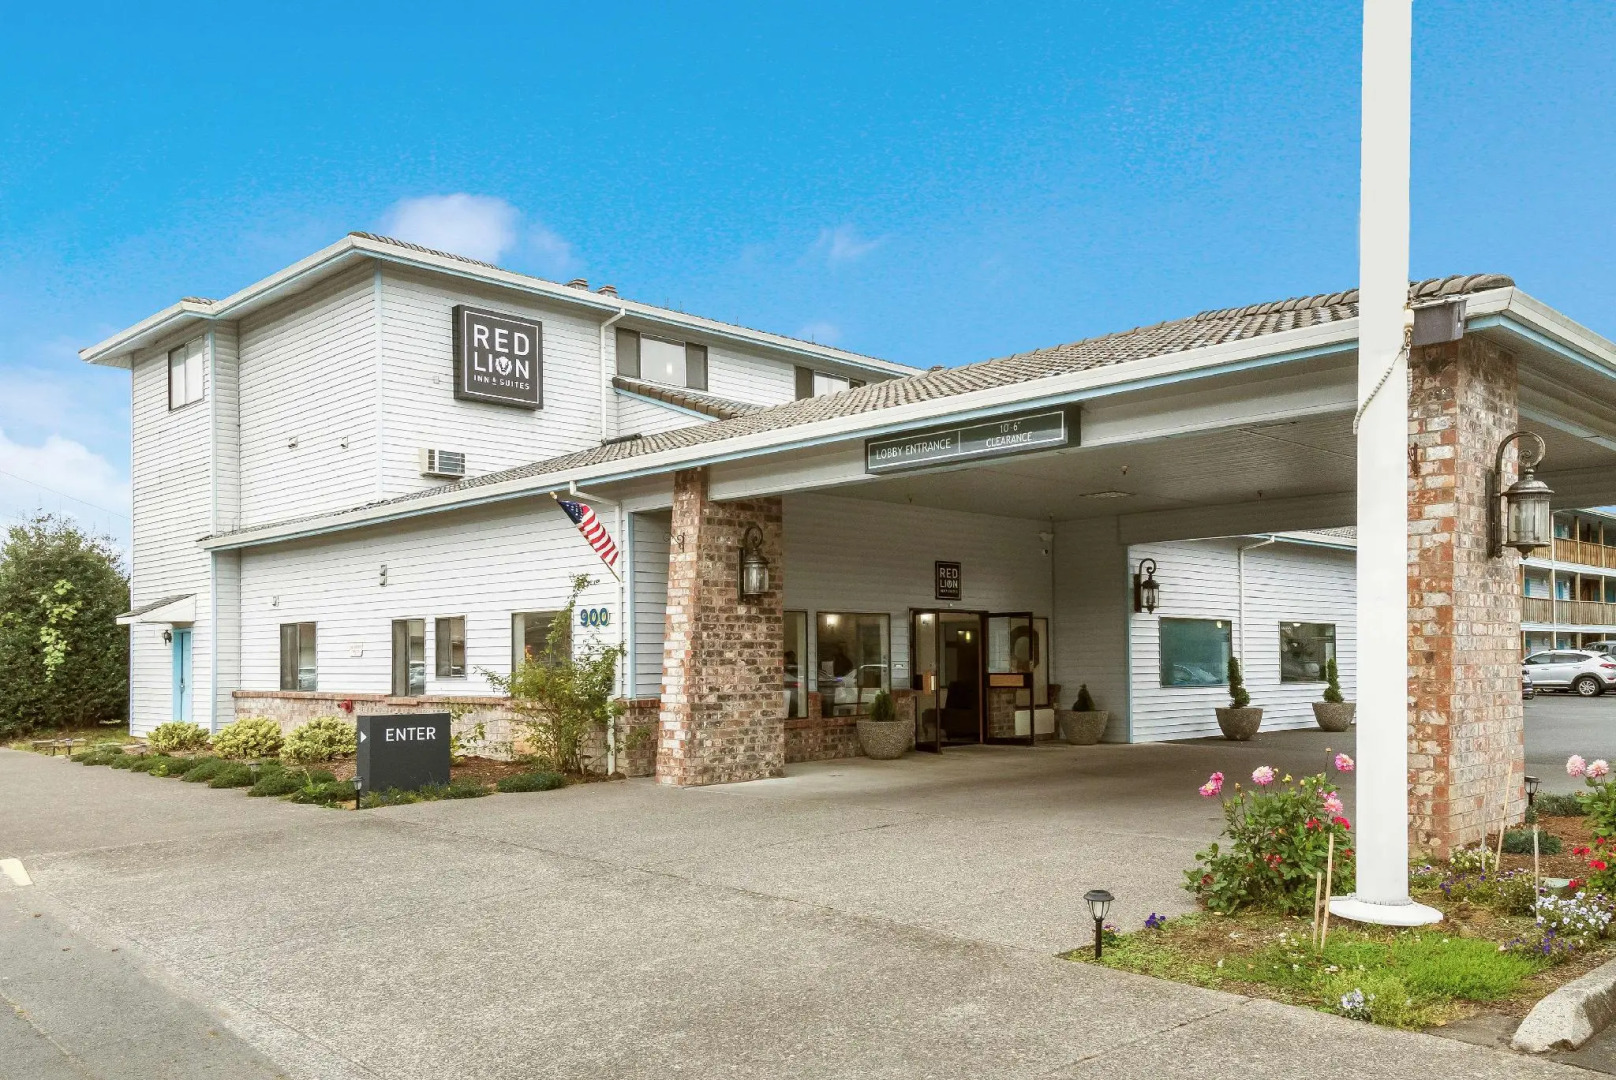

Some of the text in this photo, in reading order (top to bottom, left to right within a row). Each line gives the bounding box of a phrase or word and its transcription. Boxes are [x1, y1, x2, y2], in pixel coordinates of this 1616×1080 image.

[473, 323, 530, 356] RED
[474, 351, 530, 380] LION
[473, 374, 490, 383] INN
[499, 378, 530, 390] SUITES
[985, 431, 1034, 448] CLEARANCE
[876, 438, 952, 460] LOBBY ENTRANCE
[939, 567, 958, 579] RED
[940, 579, 958, 588] LION
[580, 607, 609, 627] 900
[385, 726, 436, 742] ENTER
